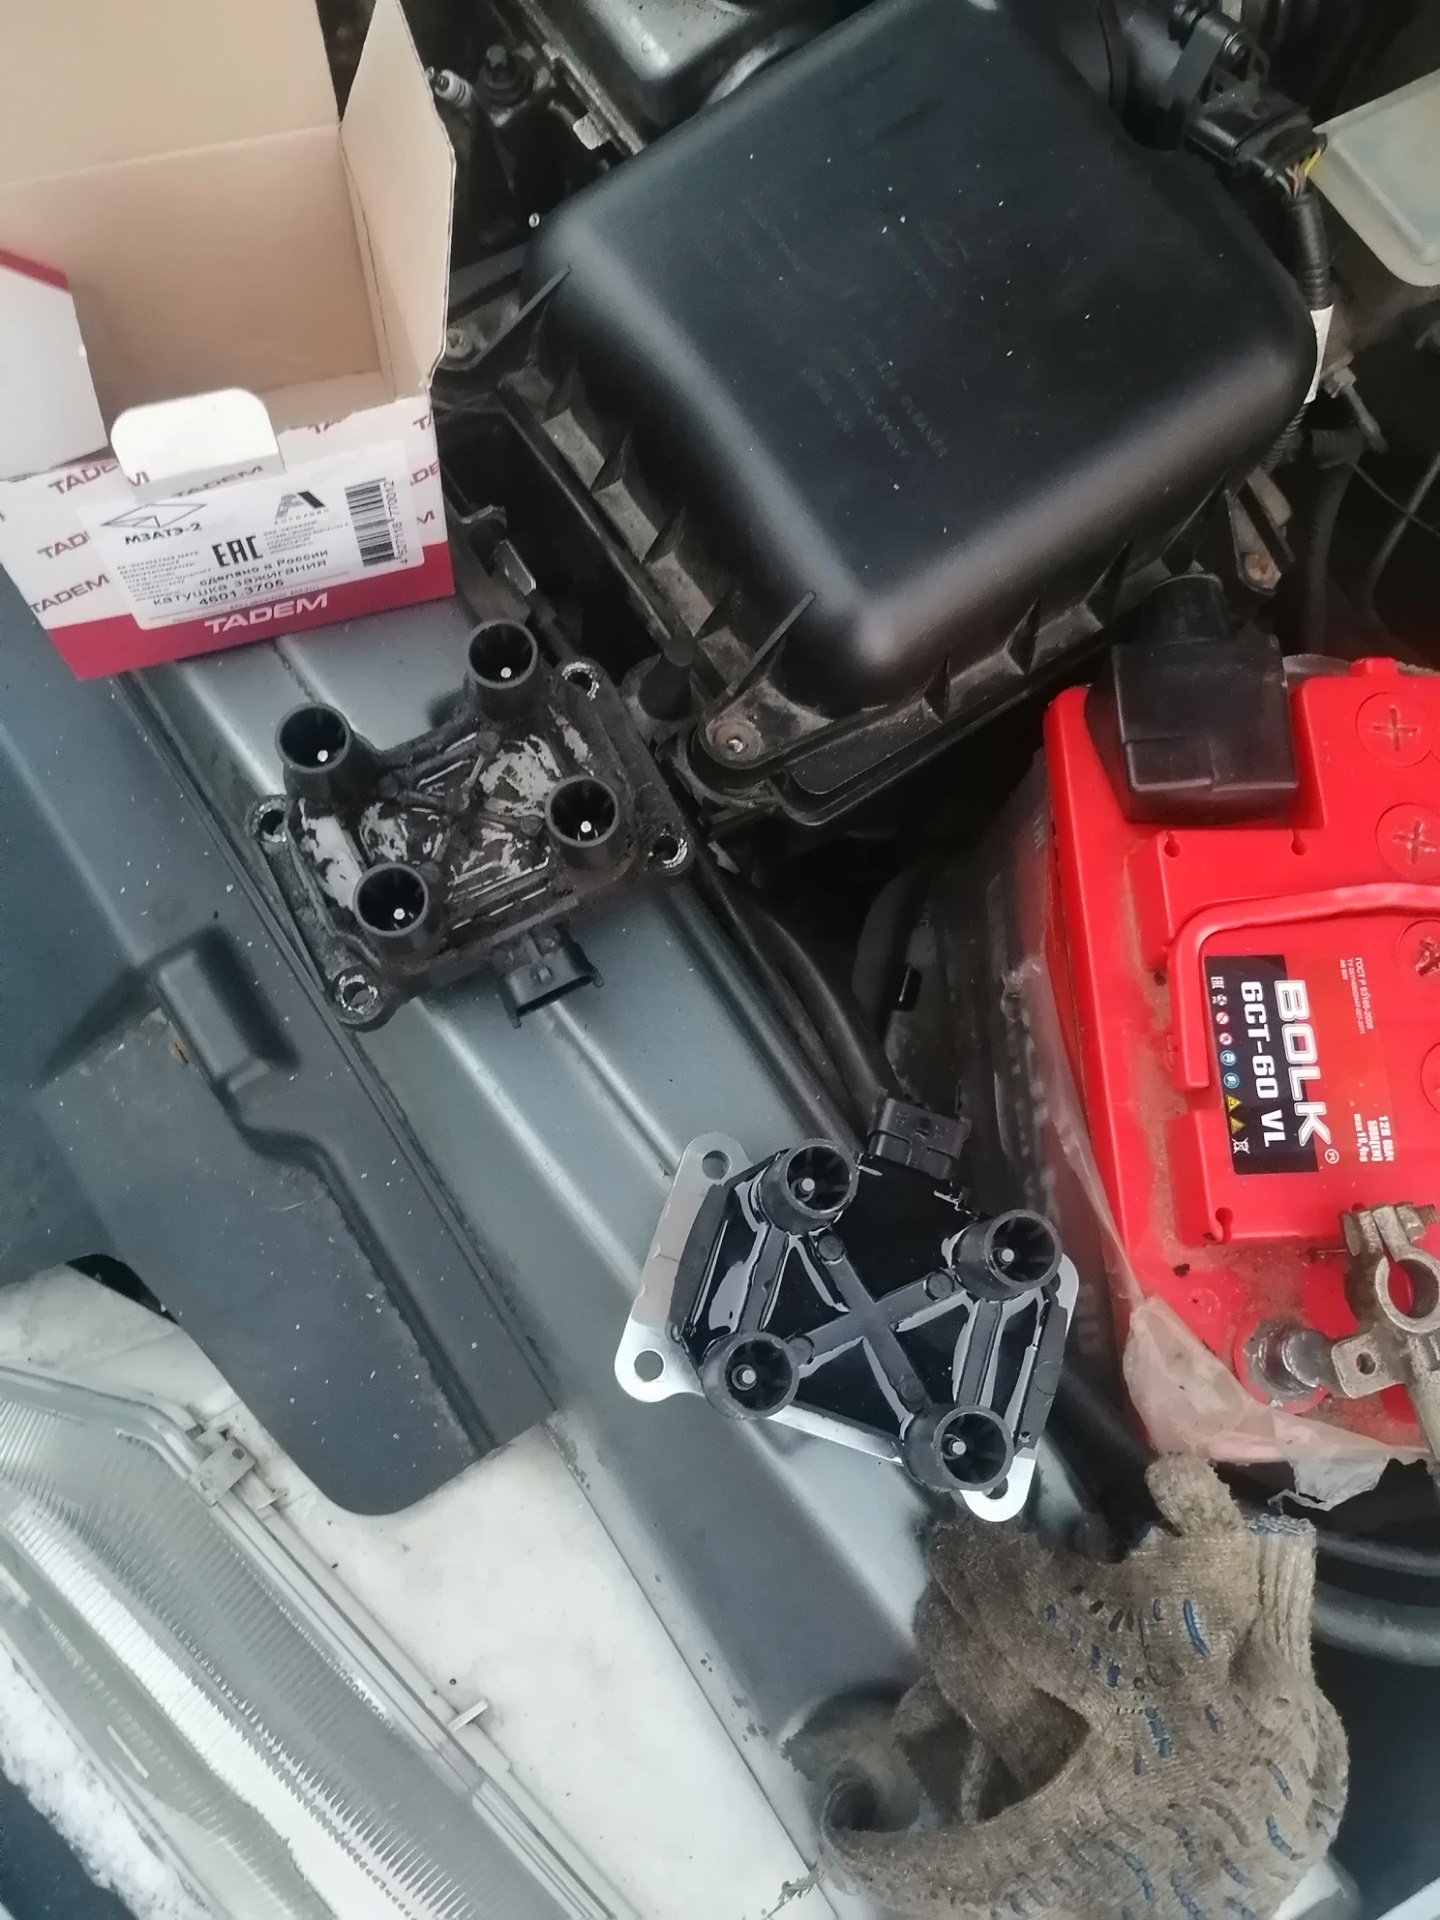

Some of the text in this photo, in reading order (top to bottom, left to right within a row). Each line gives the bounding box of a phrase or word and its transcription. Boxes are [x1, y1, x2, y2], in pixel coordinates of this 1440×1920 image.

[124, 522, 203, 545] МЗАТЭ-2
[236, 559, 328, 588] зажигания
[29, 573, 111, 615] TADEM
[204, 591, 328, 635] TADEM
[1354, 957, 1366, 978] ГОСТ
[1274, 979, 1332, 1147] BOLK
[1260, 1108, 1286, 1148] VL
